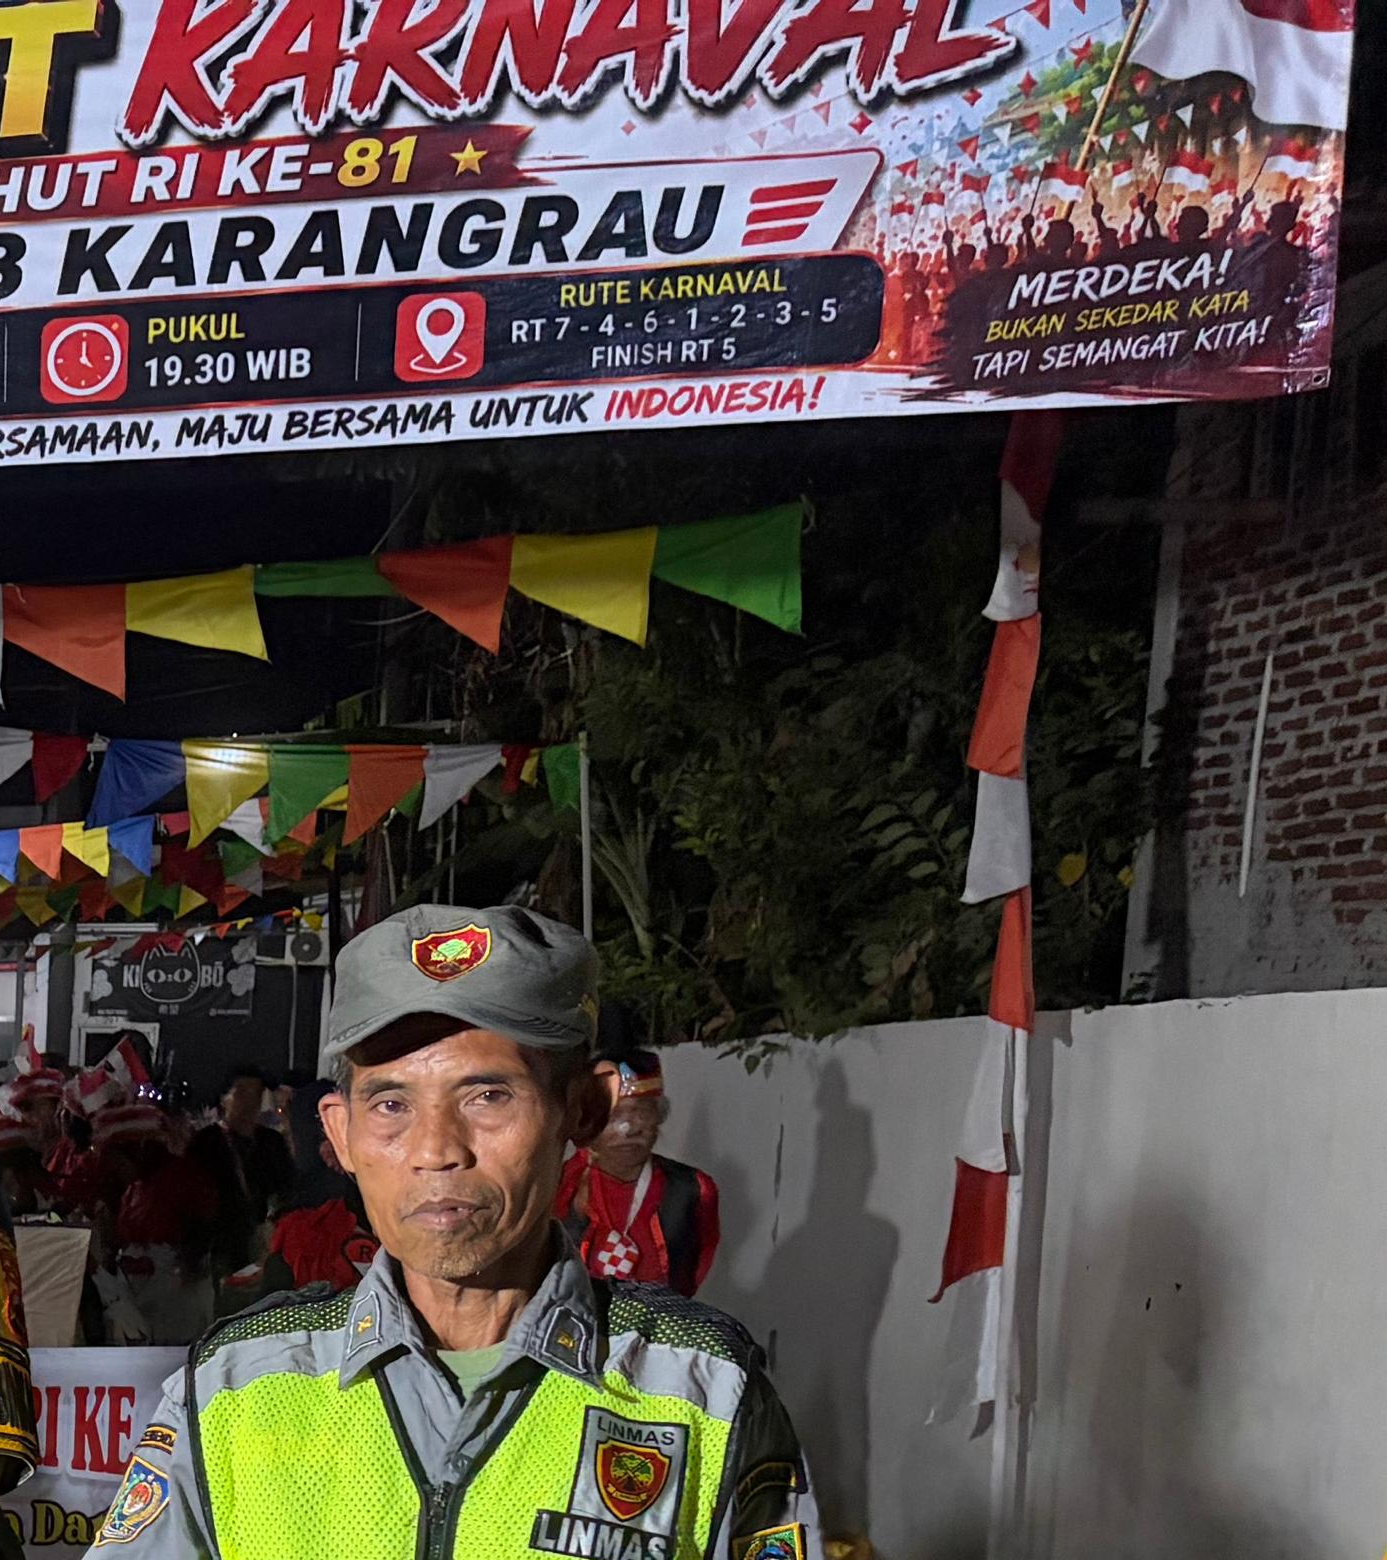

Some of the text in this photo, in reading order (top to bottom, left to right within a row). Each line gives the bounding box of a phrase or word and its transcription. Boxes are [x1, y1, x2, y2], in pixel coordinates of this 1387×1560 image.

[117, 0, 1017, 146] KARNAVAL
[130, 151, 200, 203] RI
[217, 135, 418, 197] KE-81
[56, 184, 725, 297] KARANGRAU
[560, 269, 788, 308] RUTE KARNAVAL
[1007, 248, 1234, 310] MERDEKA!
[147, 312, 246, 345] PUKUL
[511, 318, 546, 343] RT
[554, 317, 571, 340] 7
[598, 313, 615, 337] 4
[643, 310, 658, 333] 6
[686, 308, 699, 330] 1
[729, 304, 747, 328] 2
[775, 301, 792, 325] 3
[820, 298, 838, 322] 5
[984, 288, 1251, 344] BUKAN SEKEDAR KATA
[144, 348, 312, 388] 19.30 WIB
[591, 337, 737, 369] FINISH RT 5
[971, 315, 1274, 382] TAPI SEMANGAT KITA!
[177, 409, 275, 450] MAJU
[282, 399, 455, 441] BERSAMA
[468, 391, 595, 430] UNTUK
[603, 375, 827, 423] INDONESIA!
[597, 1416, 675, 1446] LINMAS
